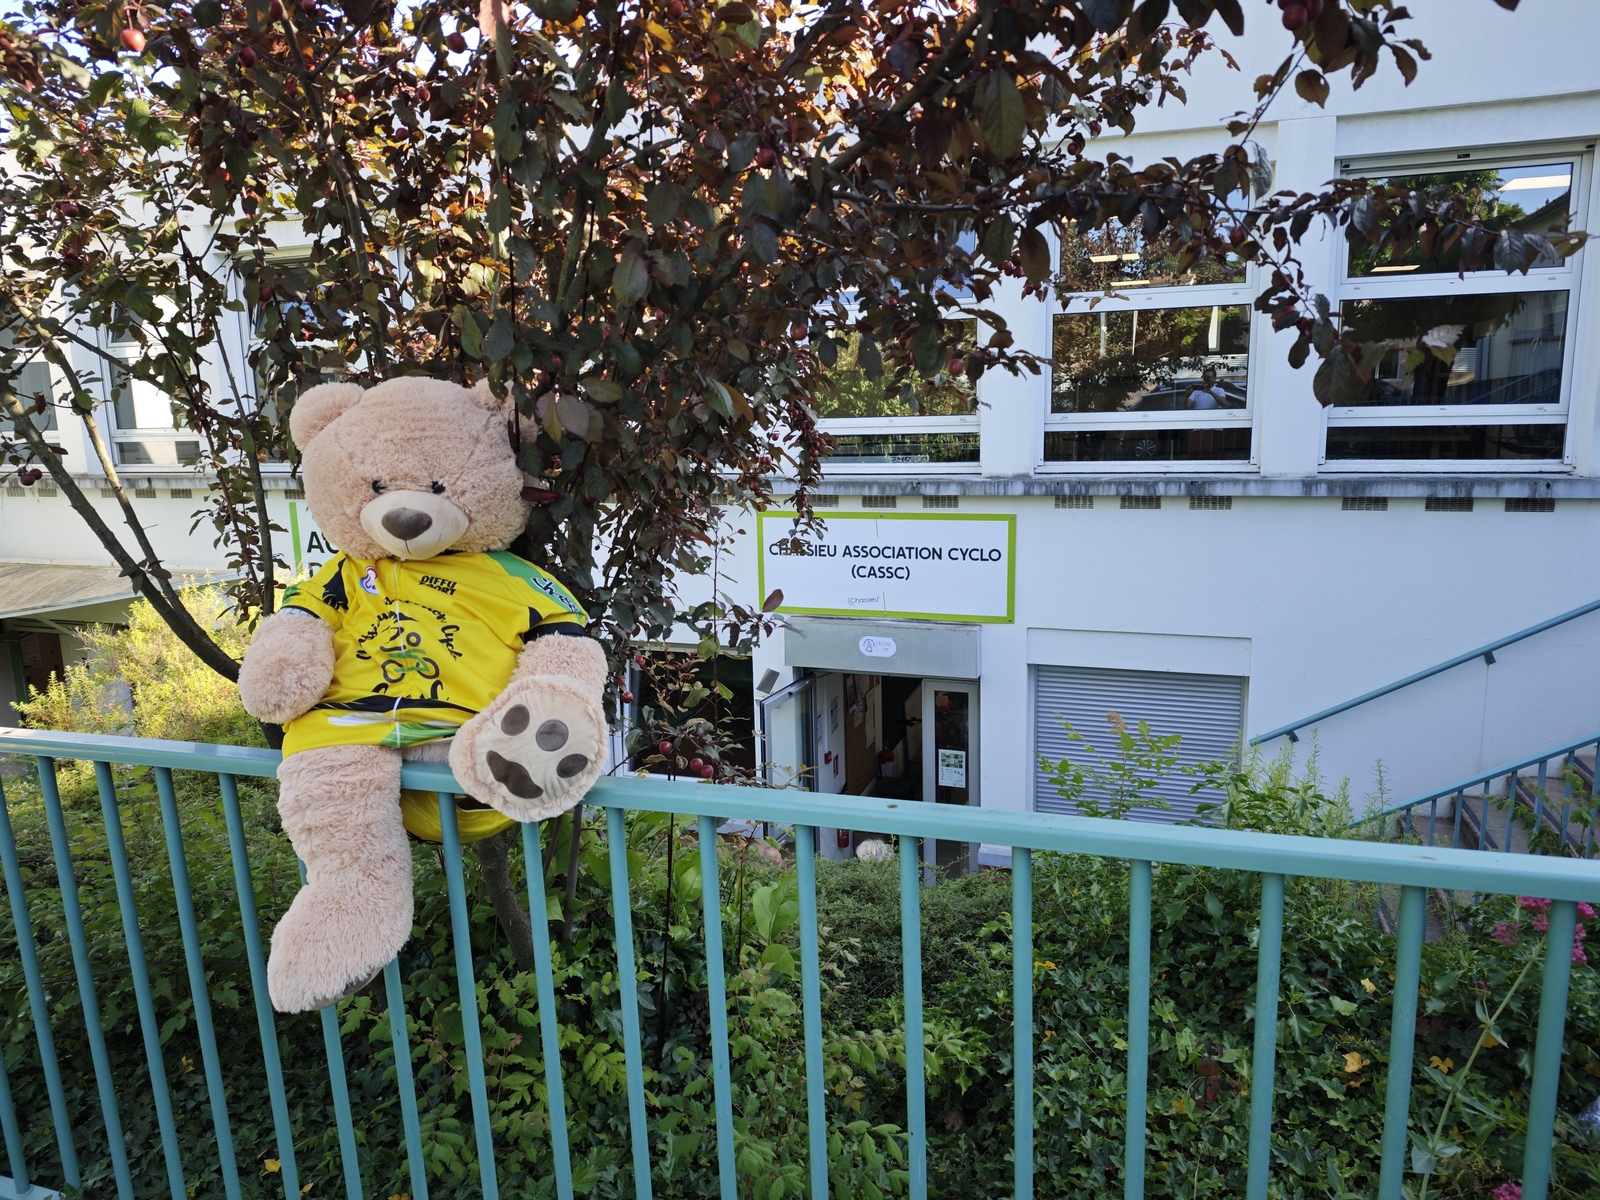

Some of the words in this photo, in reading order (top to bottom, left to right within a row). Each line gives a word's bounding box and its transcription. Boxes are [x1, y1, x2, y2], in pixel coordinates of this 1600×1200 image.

[842, 545, 943, 561] ASSOCIATION
[947, 547, 1002, 562] CYCLO
[851, 564, 911, 581] (CASSC)
[420, 575, 457, 589] DIFFU
[438, 624, 463, 661] Cycl
